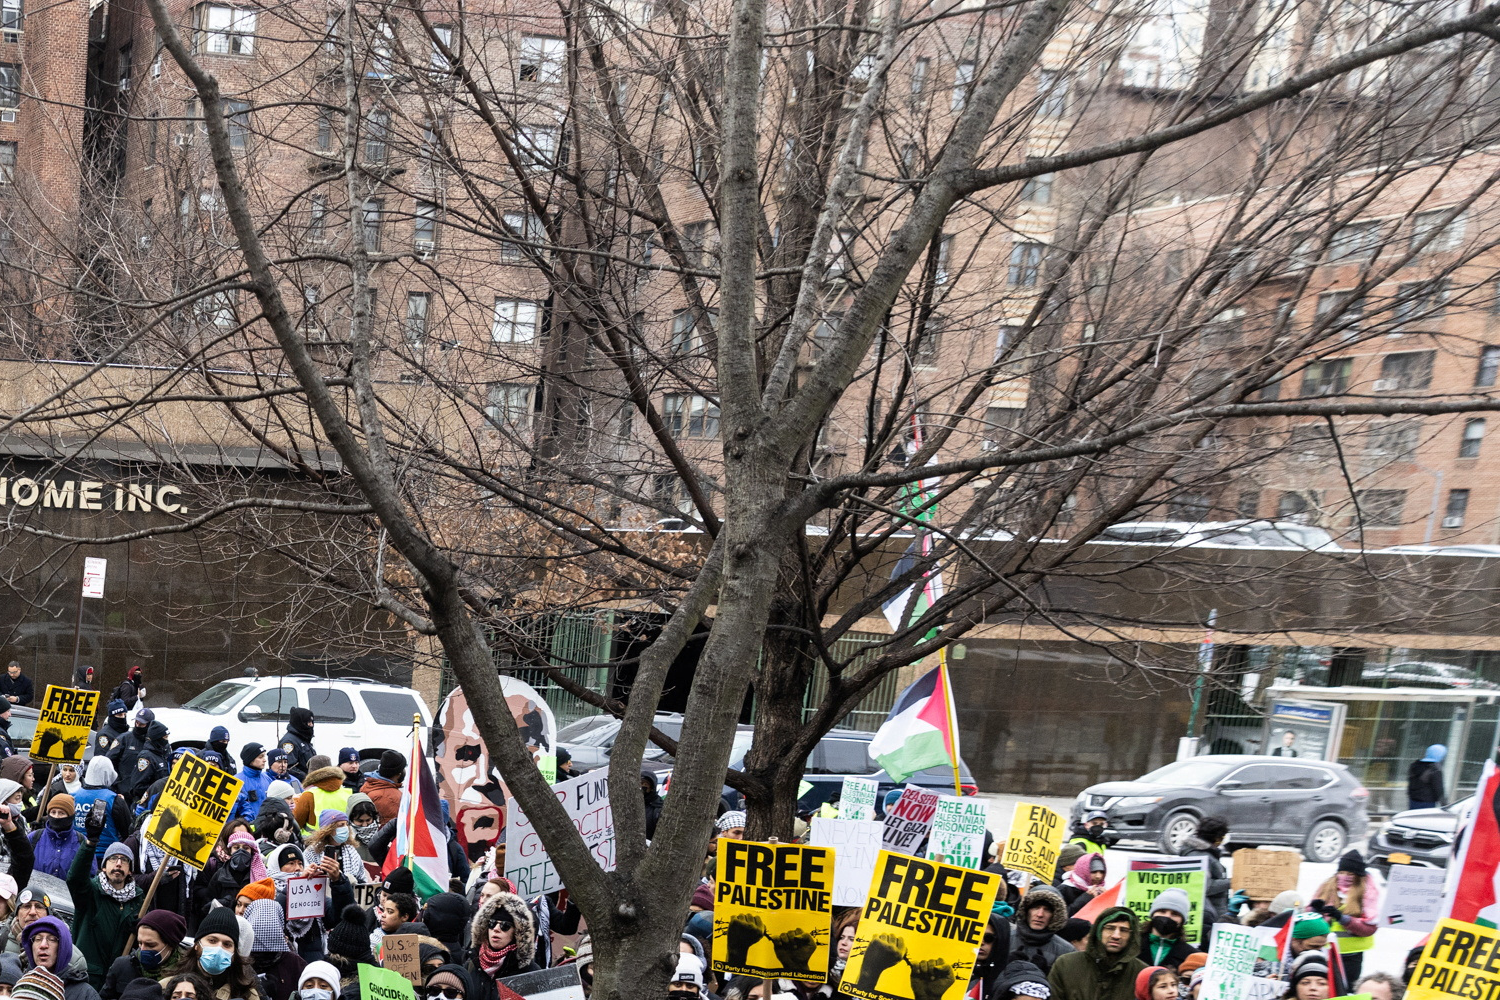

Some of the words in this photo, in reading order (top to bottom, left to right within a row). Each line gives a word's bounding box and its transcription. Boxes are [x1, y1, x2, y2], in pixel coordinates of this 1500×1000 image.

[114, 481, 189, 514] INC.
[47, 687, 96, 715] FREE
[40, 709, 93, 727] PALESTINE
[175, 753, 237, 807] FREE
[165, 779, 229, 824] PALESTINE
[893, 799, 936, 822] NOW
[937, 800, 962, 814] FREE
[965, 803, 986, 816] ALL
[885, 816, 905, 829] LET
[903, 822, 927, 835] GAZA
[936, 811, 985, 825] PALESTINIAN
[1029, 806, 1057, 828] END
[883, 827, 917, 847] LIVE!
[933, 820, 984, 835] PRISONERS
[1028, 822, 1050, 844] ALL
[1006, 851, 1019, 862] TO
[1010, 838, 1036, 854] U.S.
[1039, 846, 1056, 865] AID
[725, 842, 826, 890] FREE
[506, 860, 554, 895] FREE
[877, 854, 991, 920] FREE
[1138, 872, 1191, 884] VICTORY
[291, 885, 312, 895] USA
[717, 882, 830, 913] PALESTINE
[290, 901, 321, 909] GENOCIDE
[864, 897, 984, 945] PALESTINE
[385, 940, 407, 951] U.S.
[386, 954, 413, 962] HANDS
[391, 963, 408, 971] OFF
[724, 965, 740, 974] Party
[793, 972, 825, 980] Liberation
[369, 982, 401, 1000] GENOCIDE
[852, 987, 868, 998] Party
[868, 991, 878, 1000] for
